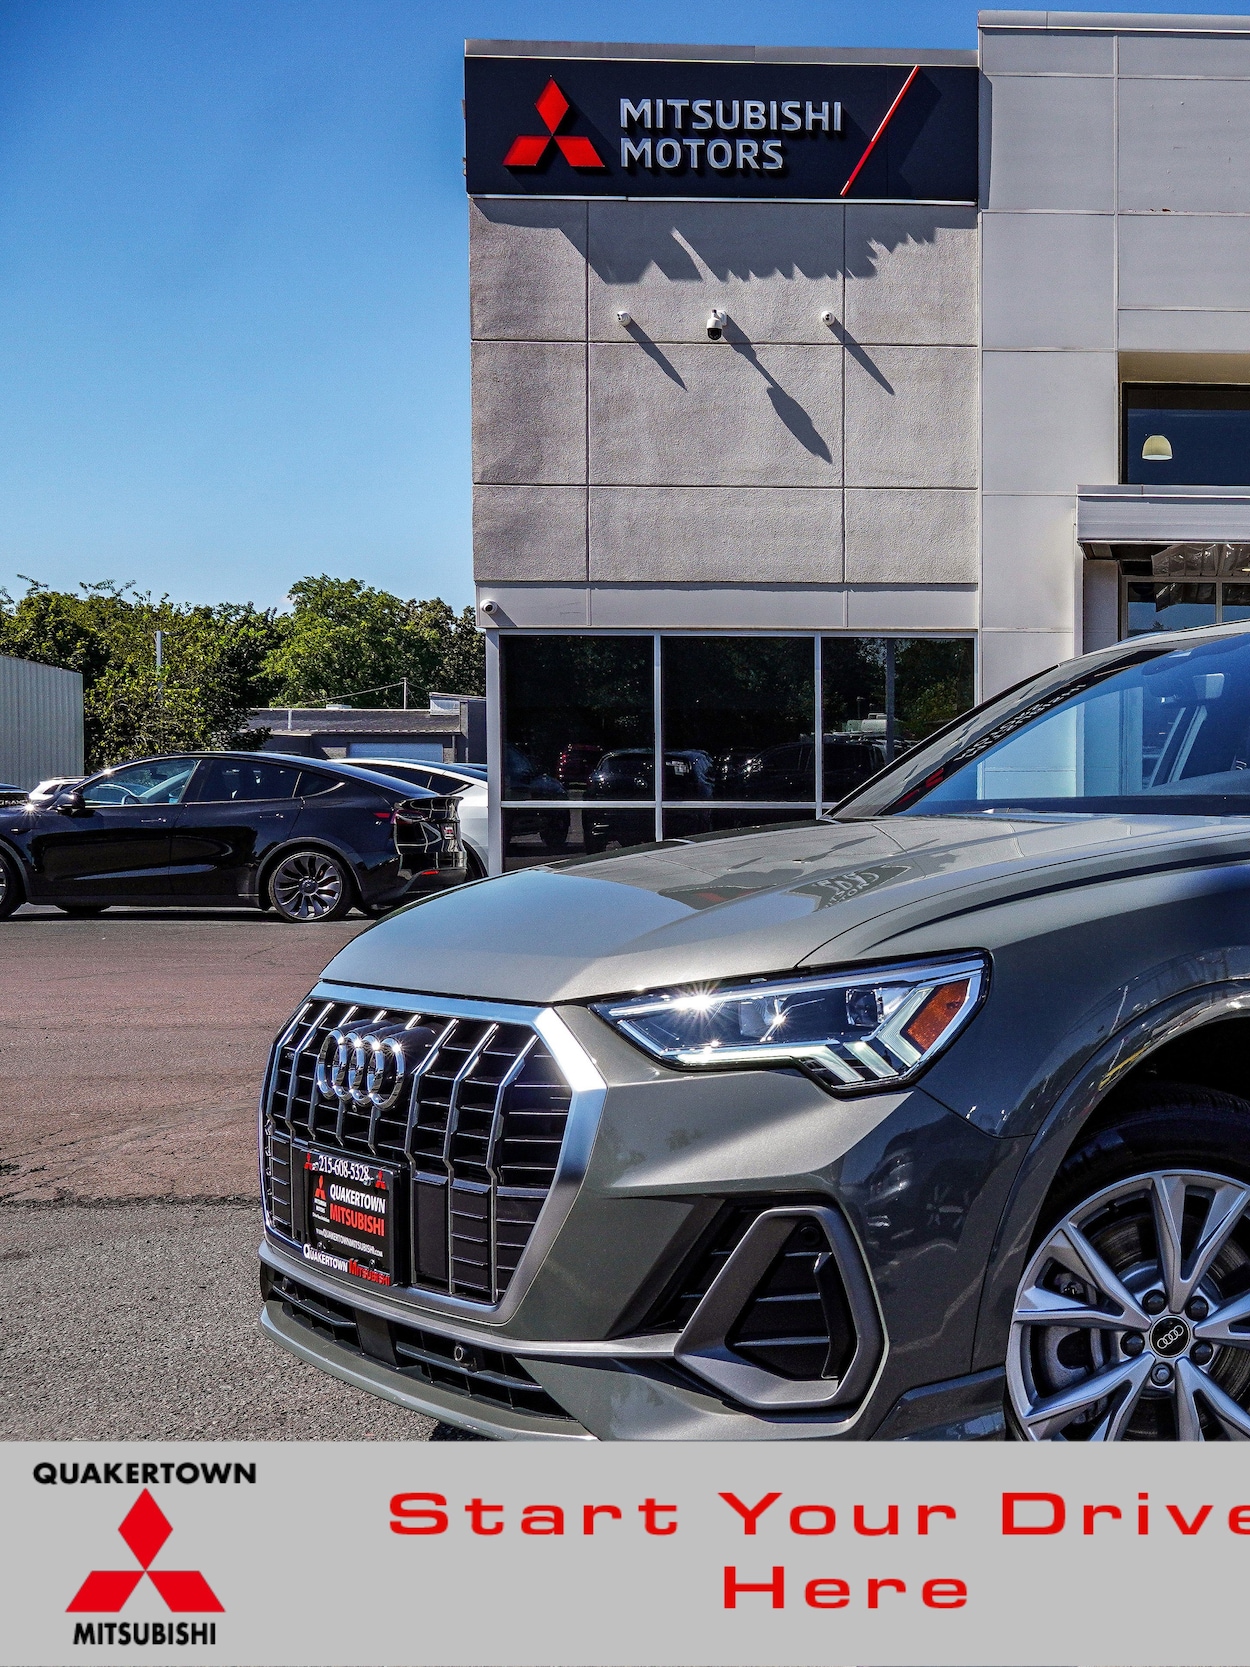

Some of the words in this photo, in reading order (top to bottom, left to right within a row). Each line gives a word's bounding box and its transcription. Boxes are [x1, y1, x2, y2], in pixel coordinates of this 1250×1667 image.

[619, 98, 844, 132] MITSUBISHI
[619, 137, 784, 171] MOTORS
[318, 1154, 370, 1182] 215-608-5328
[329, 1183, 387, 1214] QUAKERTOWN
[329, 1203, 386, 1237] MITSUBISHI
[303, 1243, 348, 1273] QUAKERTOWN
[348, 1258, 391, 1287] MITSUBISHI
